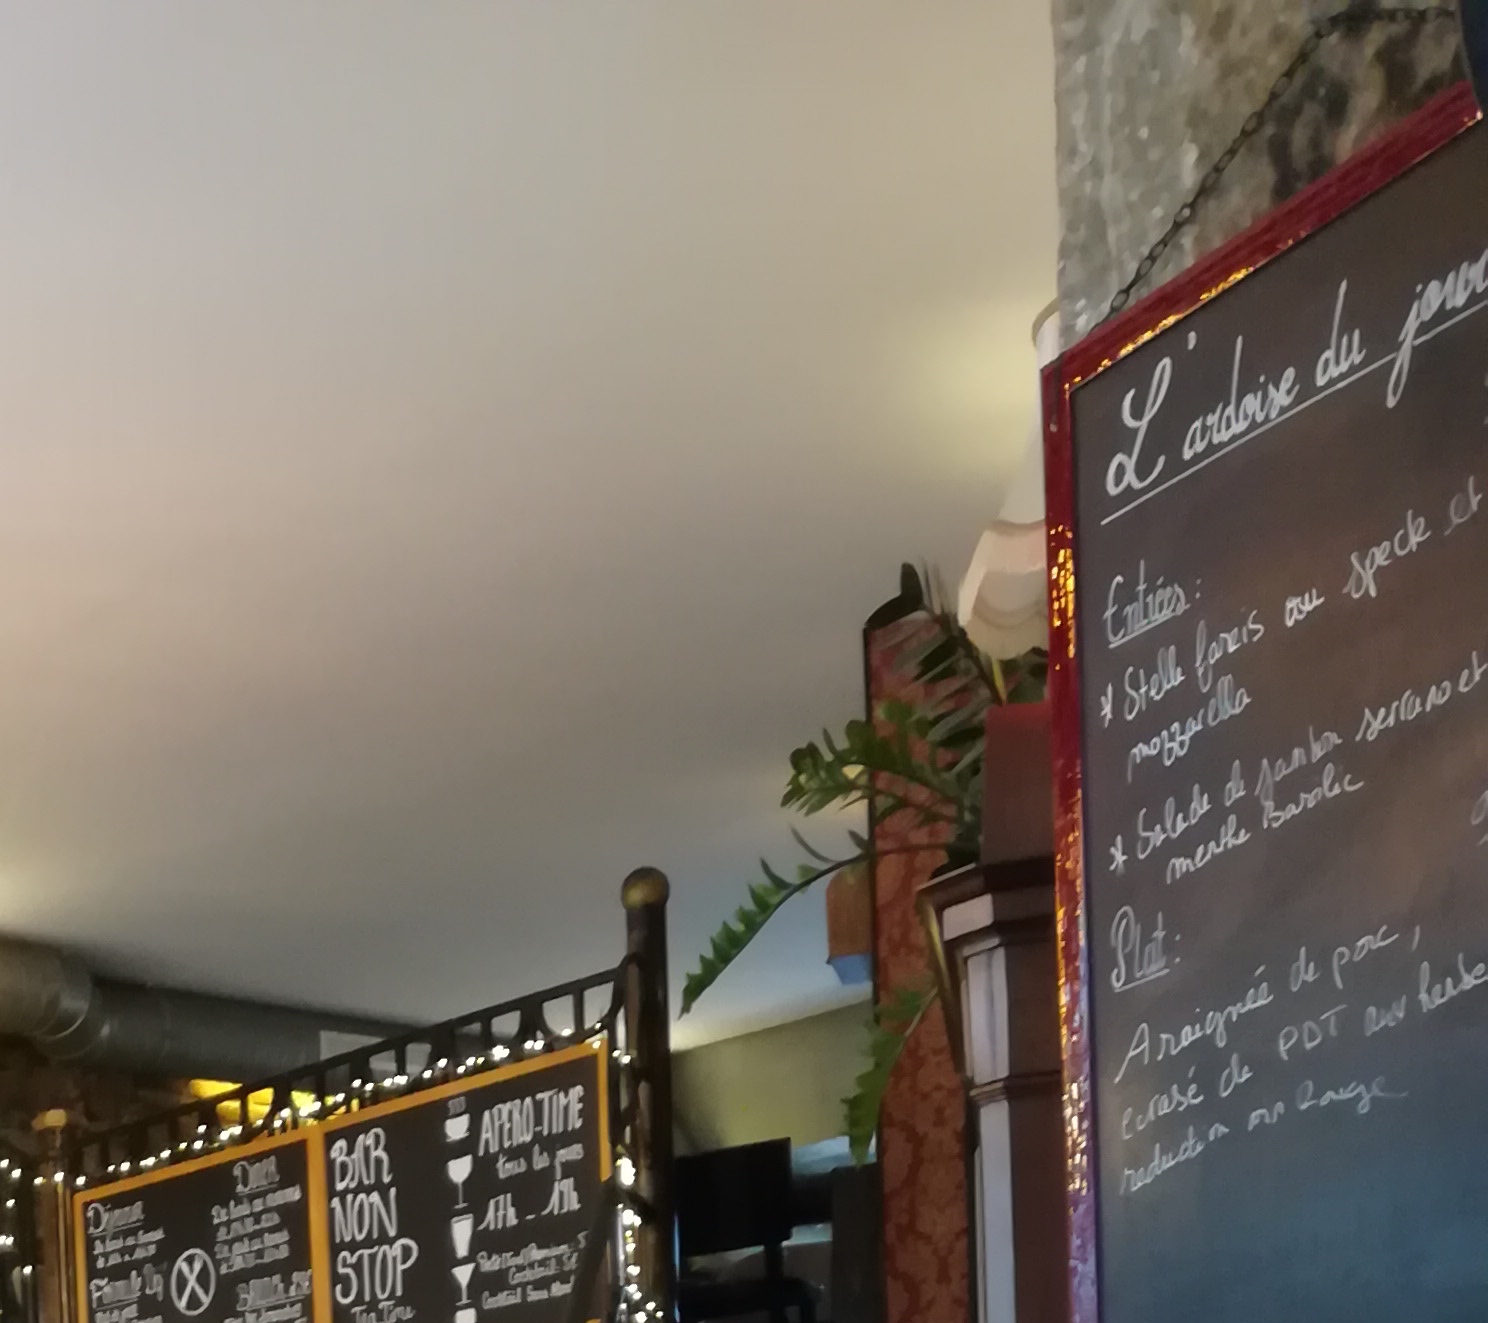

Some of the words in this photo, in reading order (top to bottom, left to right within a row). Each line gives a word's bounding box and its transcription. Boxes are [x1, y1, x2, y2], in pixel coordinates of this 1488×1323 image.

[1315, 278, 1367, 388] du
[1457, 650, 1488, 693] et
[1128, 673, 1253, 782] mozzarella
[1289, 946, 1321, 992] de
[1218, 1052, 1254, 1099] de
[1278, 1003, 1349, 1061] PDT
[330, 1127, 393, 1192] BAR
[331, 1186, 397, 1244] NON
[335, 1237, 419, 1305] STOP
